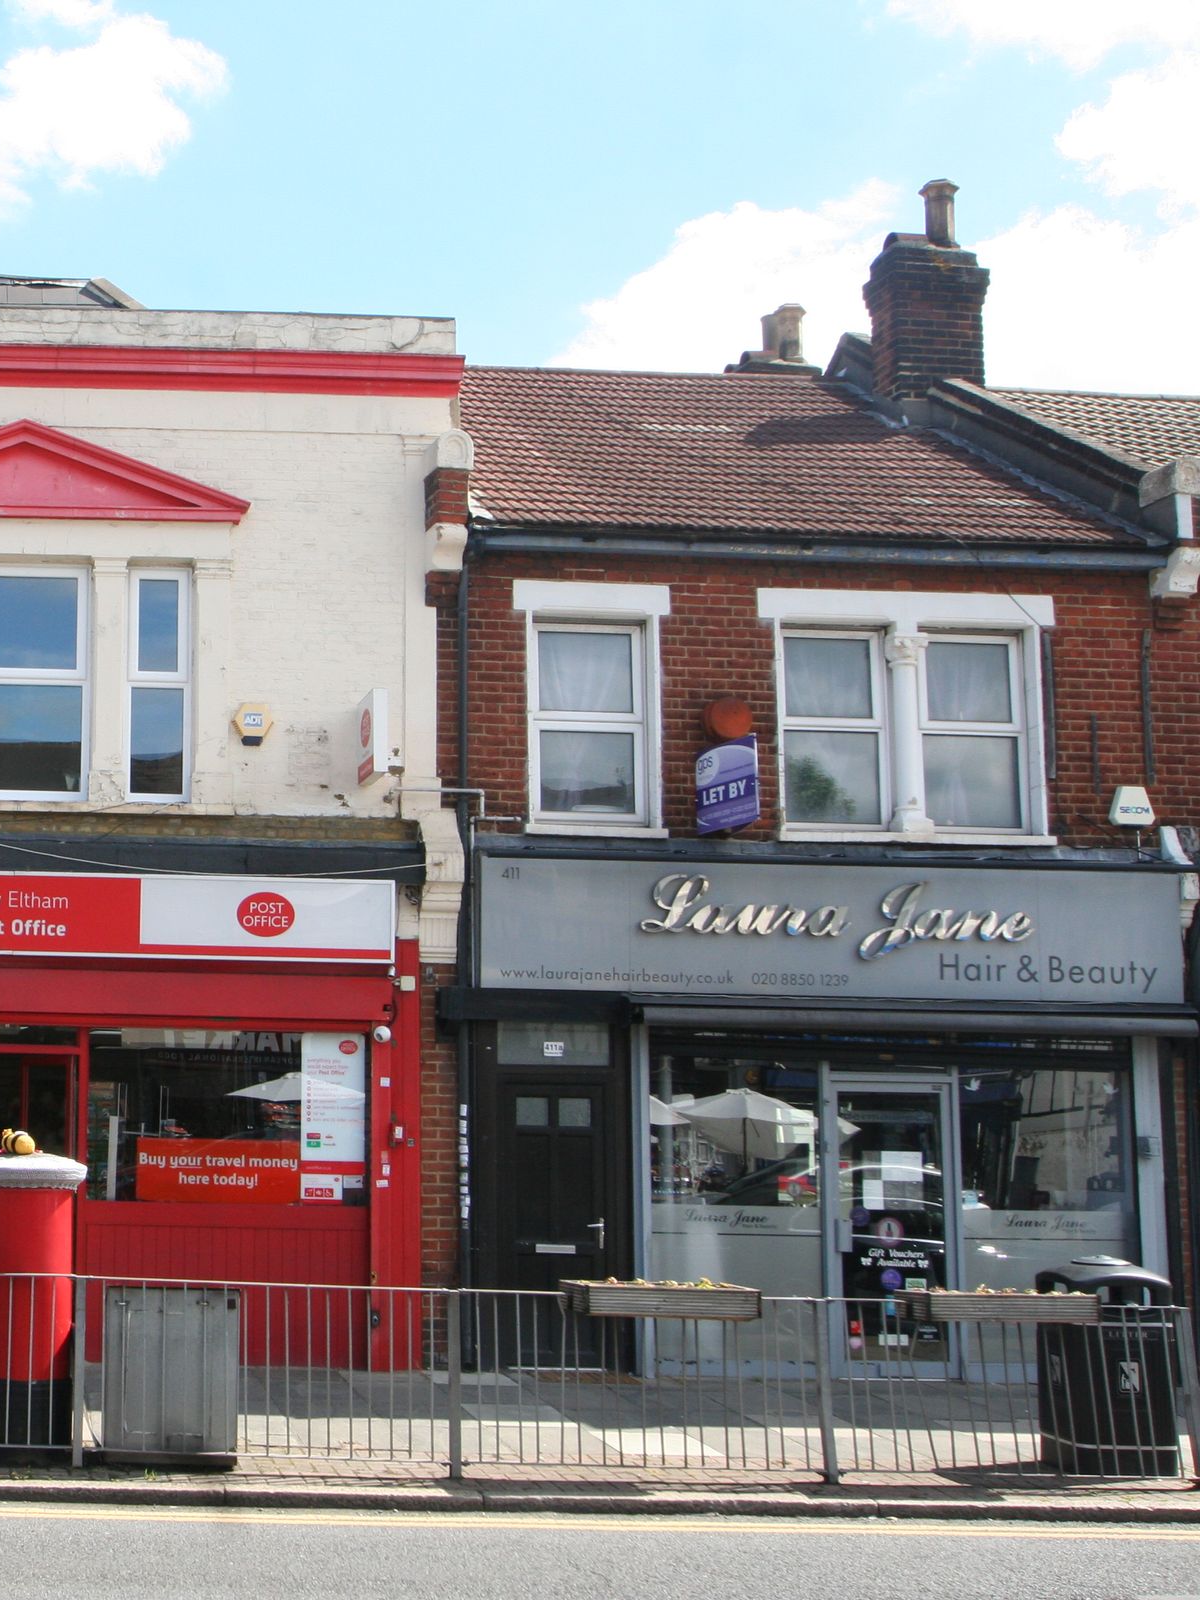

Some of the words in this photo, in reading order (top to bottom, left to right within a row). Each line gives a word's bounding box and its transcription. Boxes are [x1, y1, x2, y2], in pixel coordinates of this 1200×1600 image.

[244, 716, 263, 725] ADT
[703, 785, 726, 806] LET
[729, 779, 747, 799] BY
[1120, 806, 1150, 814] SECOM
[502, 866, 520, 880] 411
[9, 891, 69, 910] Eltham
[250, 902, 284, 914] POST
[243, 915, 289, 928] OFFICE
[640, 872, 852, 937] Laura
[859, 880, 1036, 962] Jane
[12, 919, 66, 937] Office
[500, 967, 734, 988] www.laurajanehairbeauty.co.uk
[752, 973, 777, 986] 020
[781, 974, 815, 986] 8850
[820, 974, 849, 987] 1239
[939, 953, 1007, 982] Hair
[1017, 955, 1039, 983] &
[1048, 955, 1158, 994] Beauty
[139, 1152, 166, 1167] Buy
[170, 1156, 202, 1170] your
[205, 1155, 245, 1168] travel
[250, 1158, 298, 1172] money
[179, 1172, 210, 1185] here
[212, 1173, 258, 1189] today!
[729, 1209, 768, 1228] Jane
[1004, 1214, 1048, 1228] Laura
[868, 1248, 885, 1258] Gift
[889, 1248, 925, 1259] Vouchers
